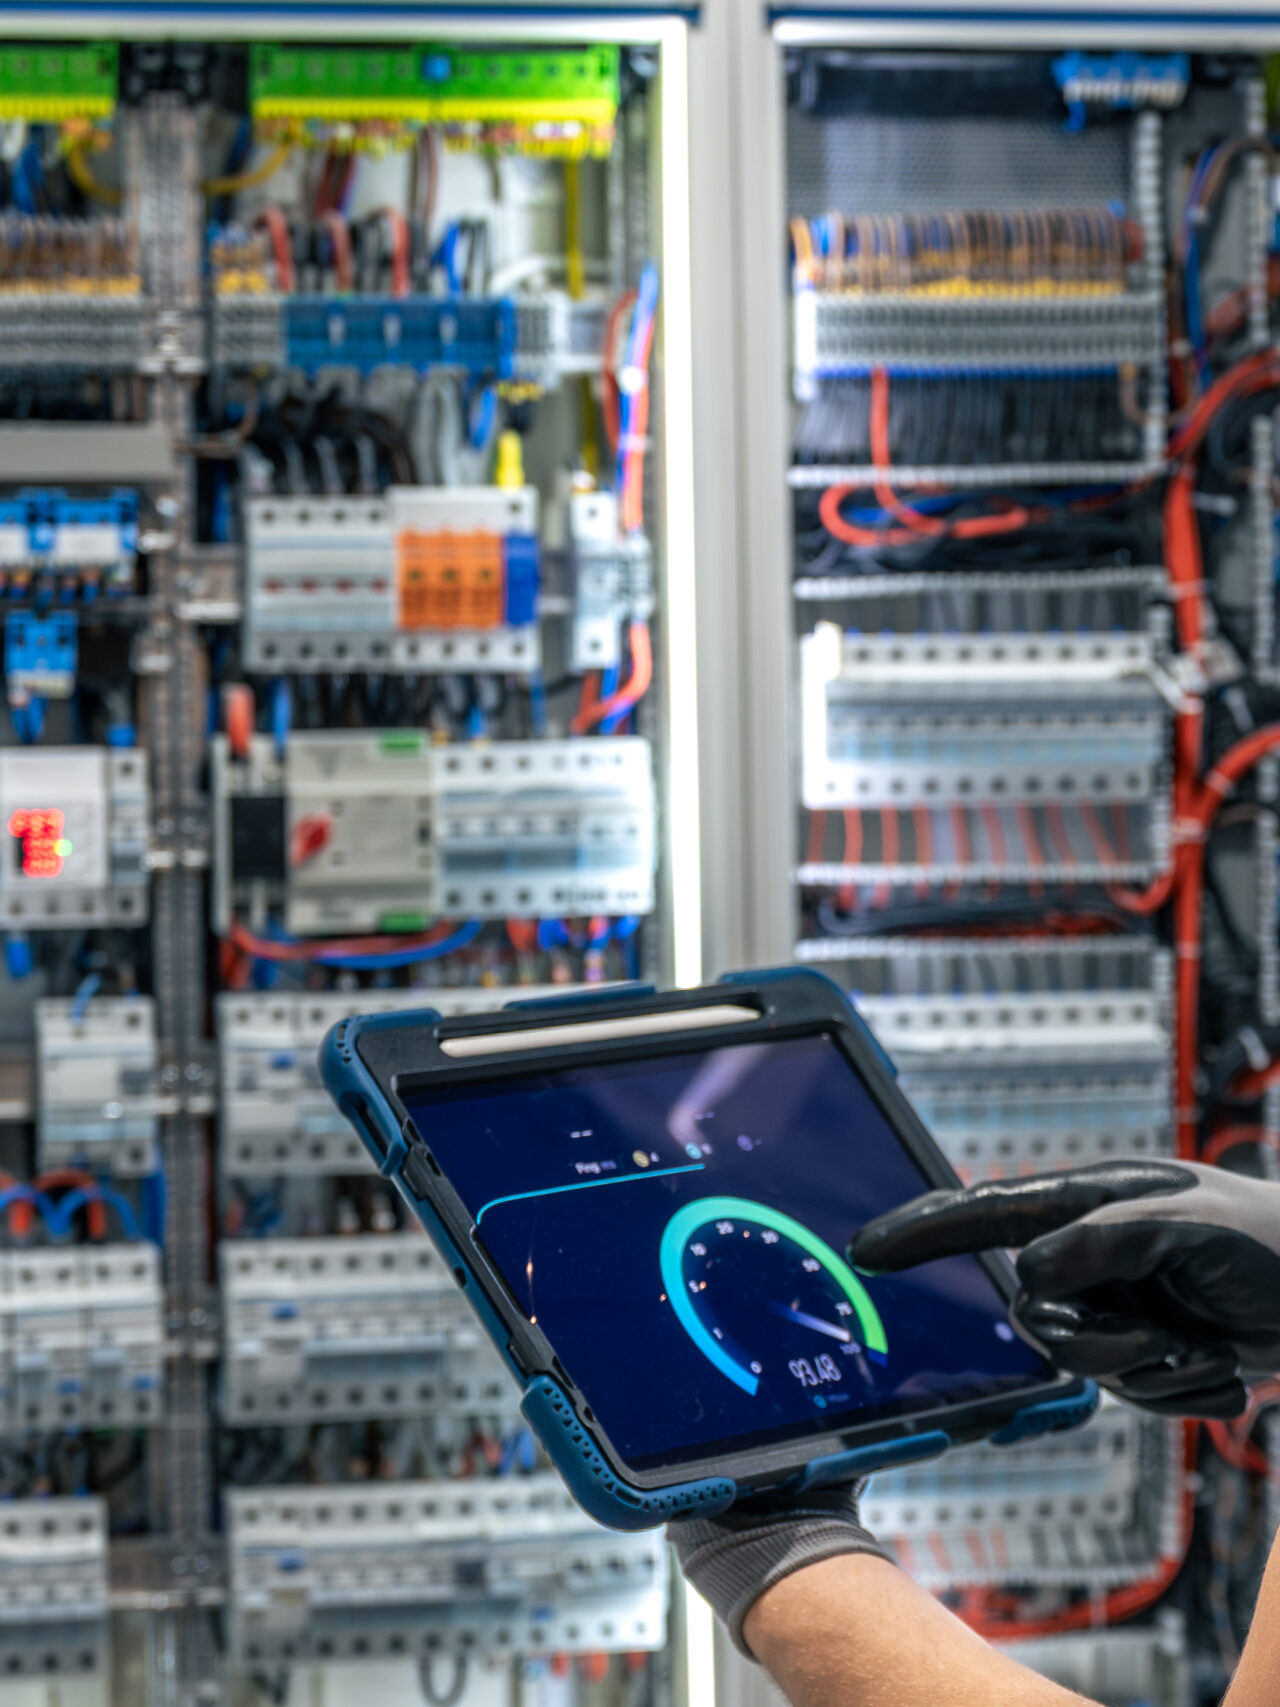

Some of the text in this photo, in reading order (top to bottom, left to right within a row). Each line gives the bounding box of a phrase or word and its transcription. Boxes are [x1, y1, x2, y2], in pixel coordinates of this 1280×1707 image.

[575, 1162, 601, 1175] Ping
[689, 1280, 700, 1293] 5
[750, 1360, 762, 1374] 0
[788, 1353, 842, 1387] 93.48
